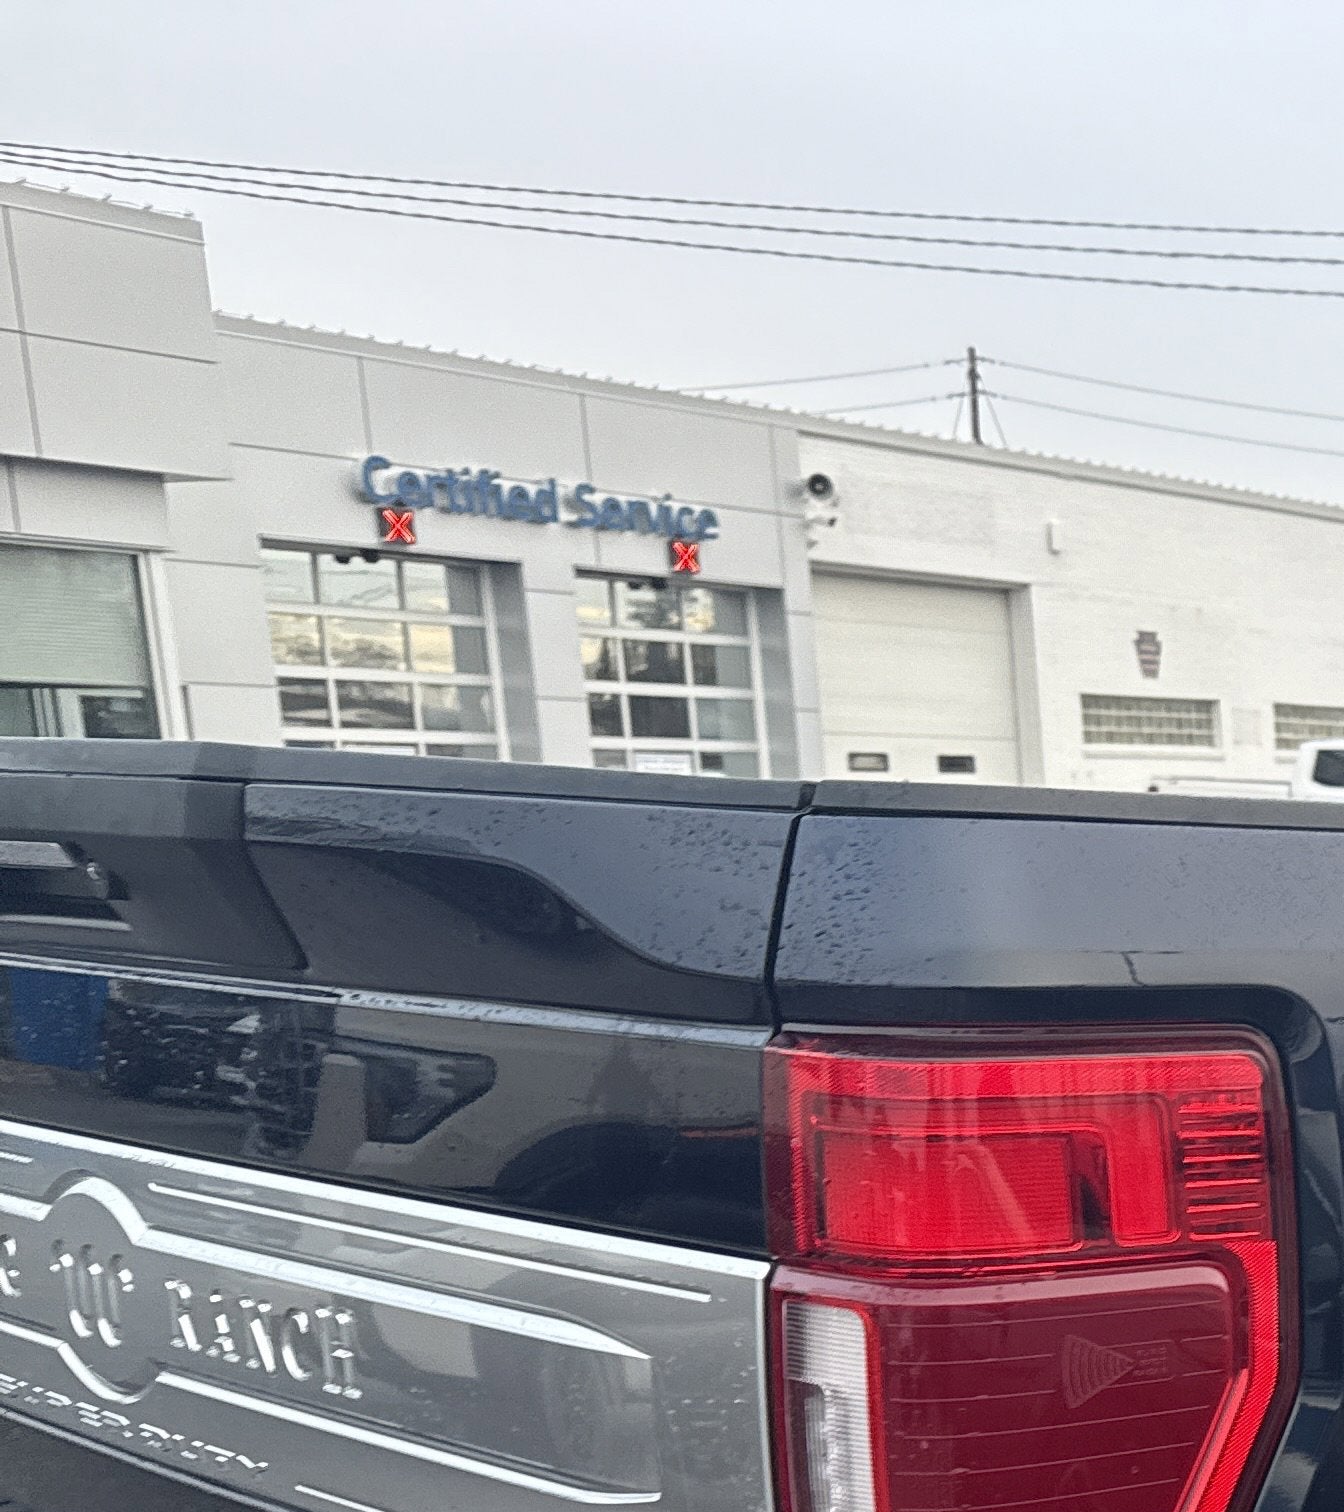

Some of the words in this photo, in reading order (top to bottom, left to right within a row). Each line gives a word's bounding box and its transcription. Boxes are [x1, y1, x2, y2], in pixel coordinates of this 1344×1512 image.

[362, 455, 558, 524] Certified
[568, 482, 719, 541] Service
[164, 1279, 363, 1400] RANCH
